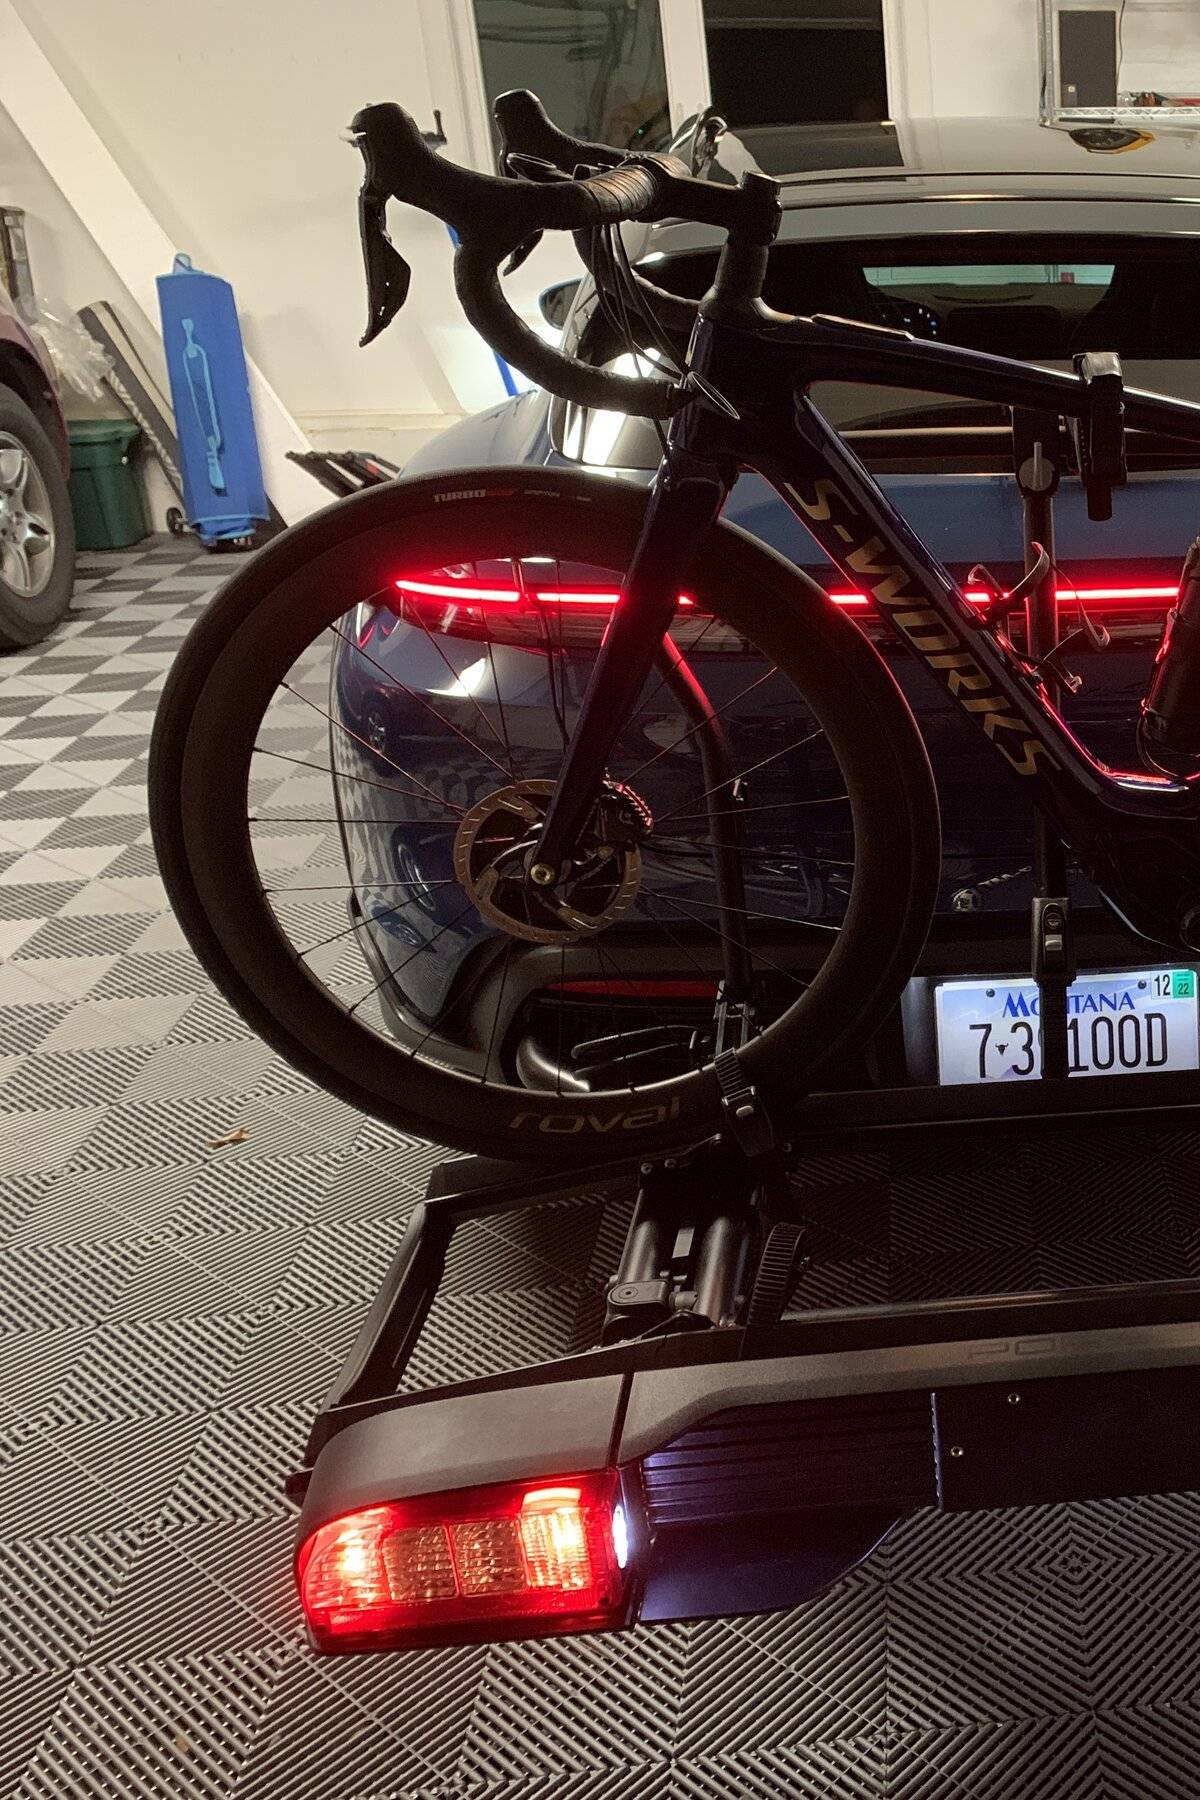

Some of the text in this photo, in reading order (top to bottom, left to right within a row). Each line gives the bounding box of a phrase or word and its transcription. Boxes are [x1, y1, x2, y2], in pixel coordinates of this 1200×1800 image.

[784, 479, 1062, 775] S-WORKS
[1154, 974, 1170, 996] 12
[1178, 983, 1189, 995] 22
[1002, 991, 1136, 1018] MTANA
[510, 1097, 680, 1133] roval
